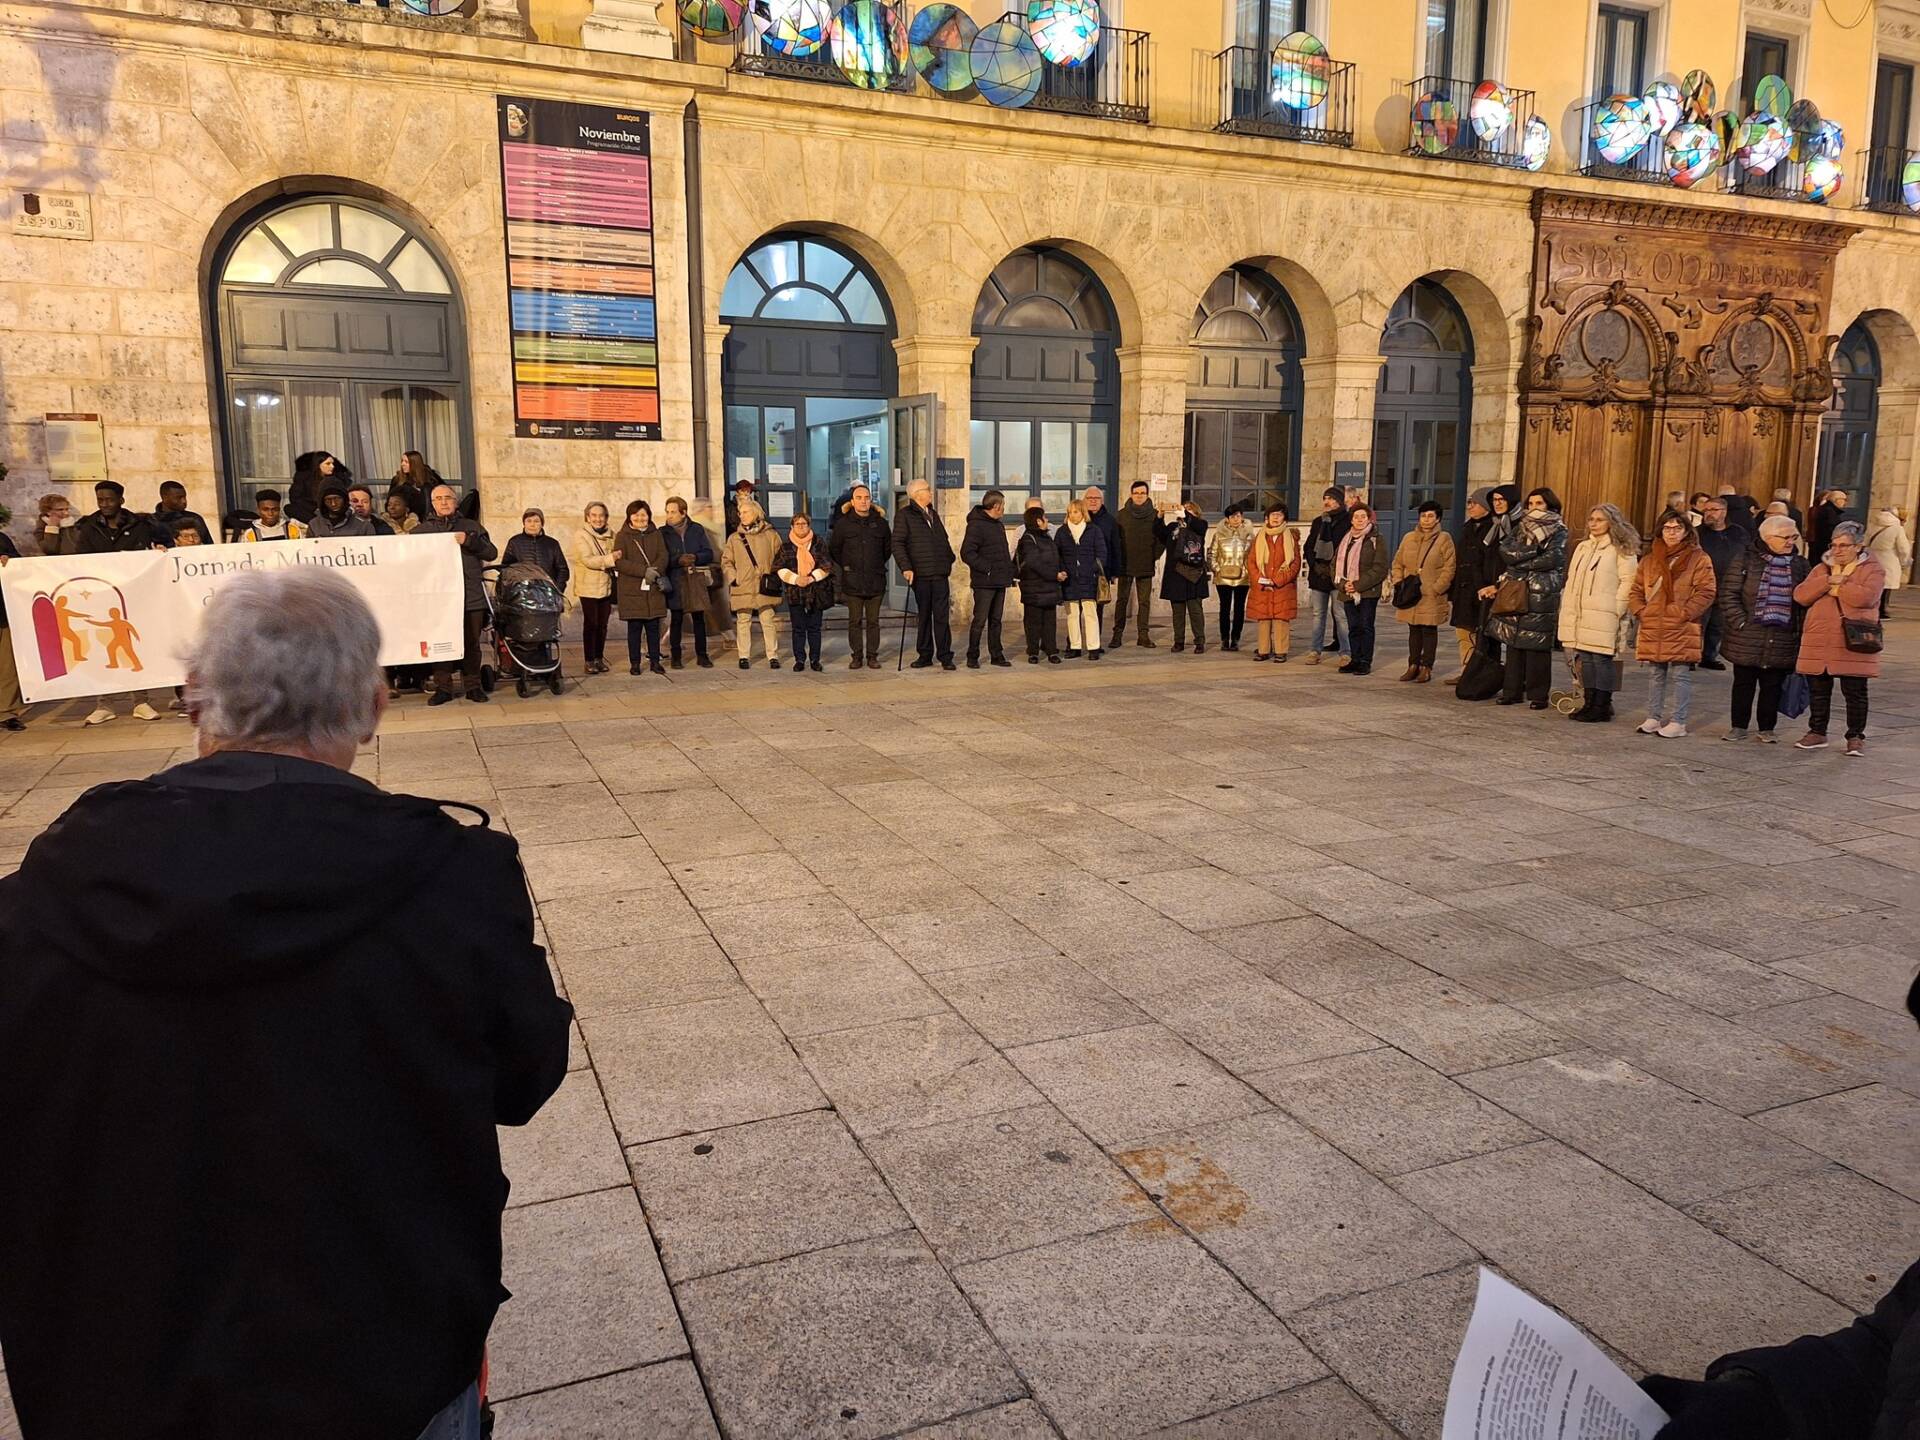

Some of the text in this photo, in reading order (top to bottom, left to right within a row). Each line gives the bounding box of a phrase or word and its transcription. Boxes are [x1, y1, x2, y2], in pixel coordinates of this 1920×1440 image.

[579, 126, 641, 143] Noviembre
[172, 546, 377, 583] Jornada Mundial
